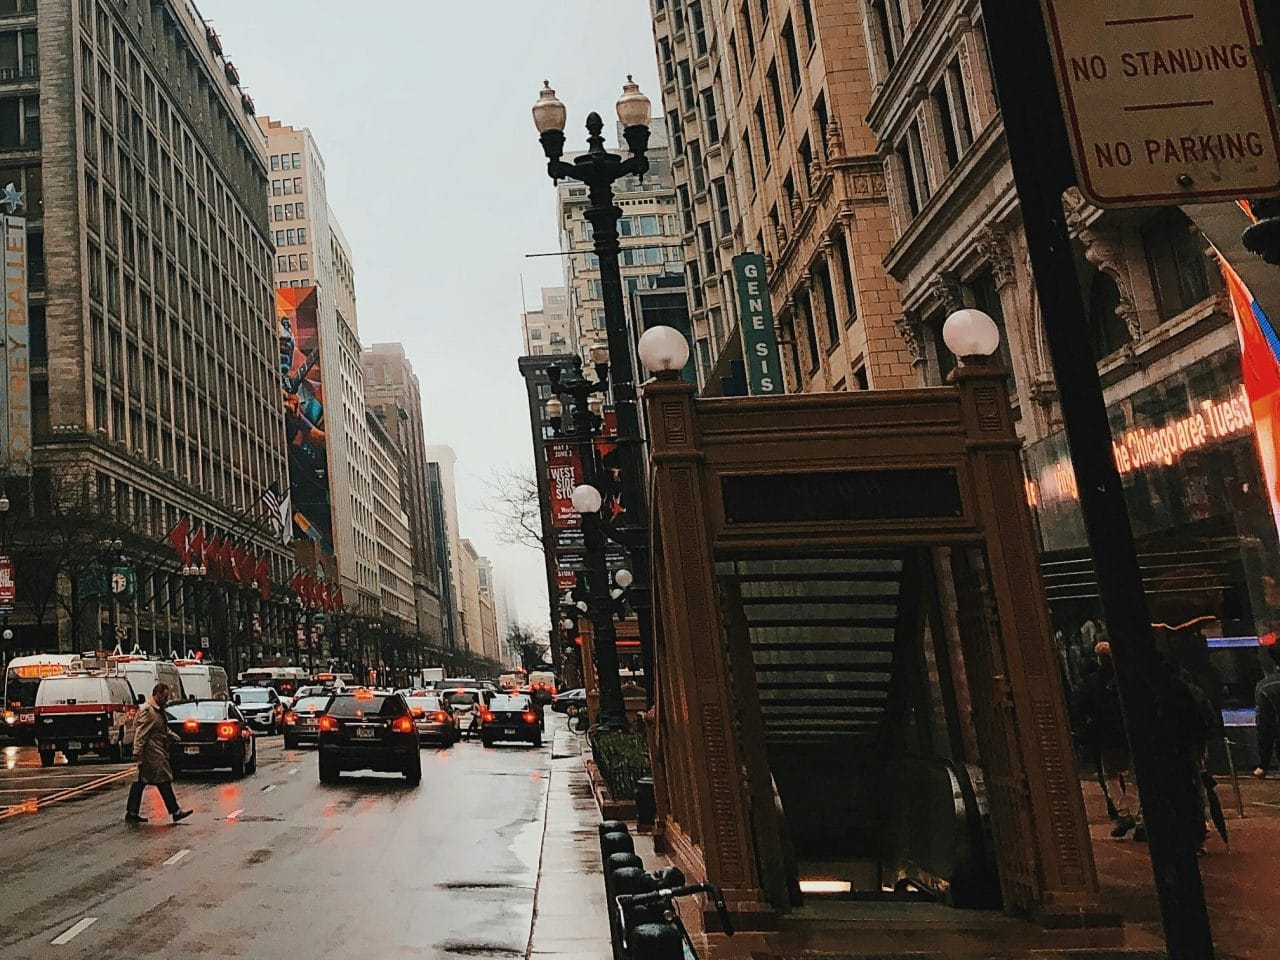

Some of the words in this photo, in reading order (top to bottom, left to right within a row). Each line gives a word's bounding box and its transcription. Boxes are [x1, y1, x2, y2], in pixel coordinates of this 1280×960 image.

[1071, 55, 1107, 82] NO
[1122, 43, 1248, 78] STANDING
[1094, 141, 1132, 168] NO
[1145, 132, 1264, 164] PARKING
[6, 218, 27, 326] BALLET
[8, 335, 30, 460] OFFREY
[1112, 440, 1131, 473] he
[1126, 425, 1177, 466] Chicago
[1176, 412, 1207, 450] area
[1200, 384, 1253, 438] Tuesd
[551, 467, 575, 480] WEST
[556, 478, 576, 490] SIDE
[556, 488, 574, 500] STO
